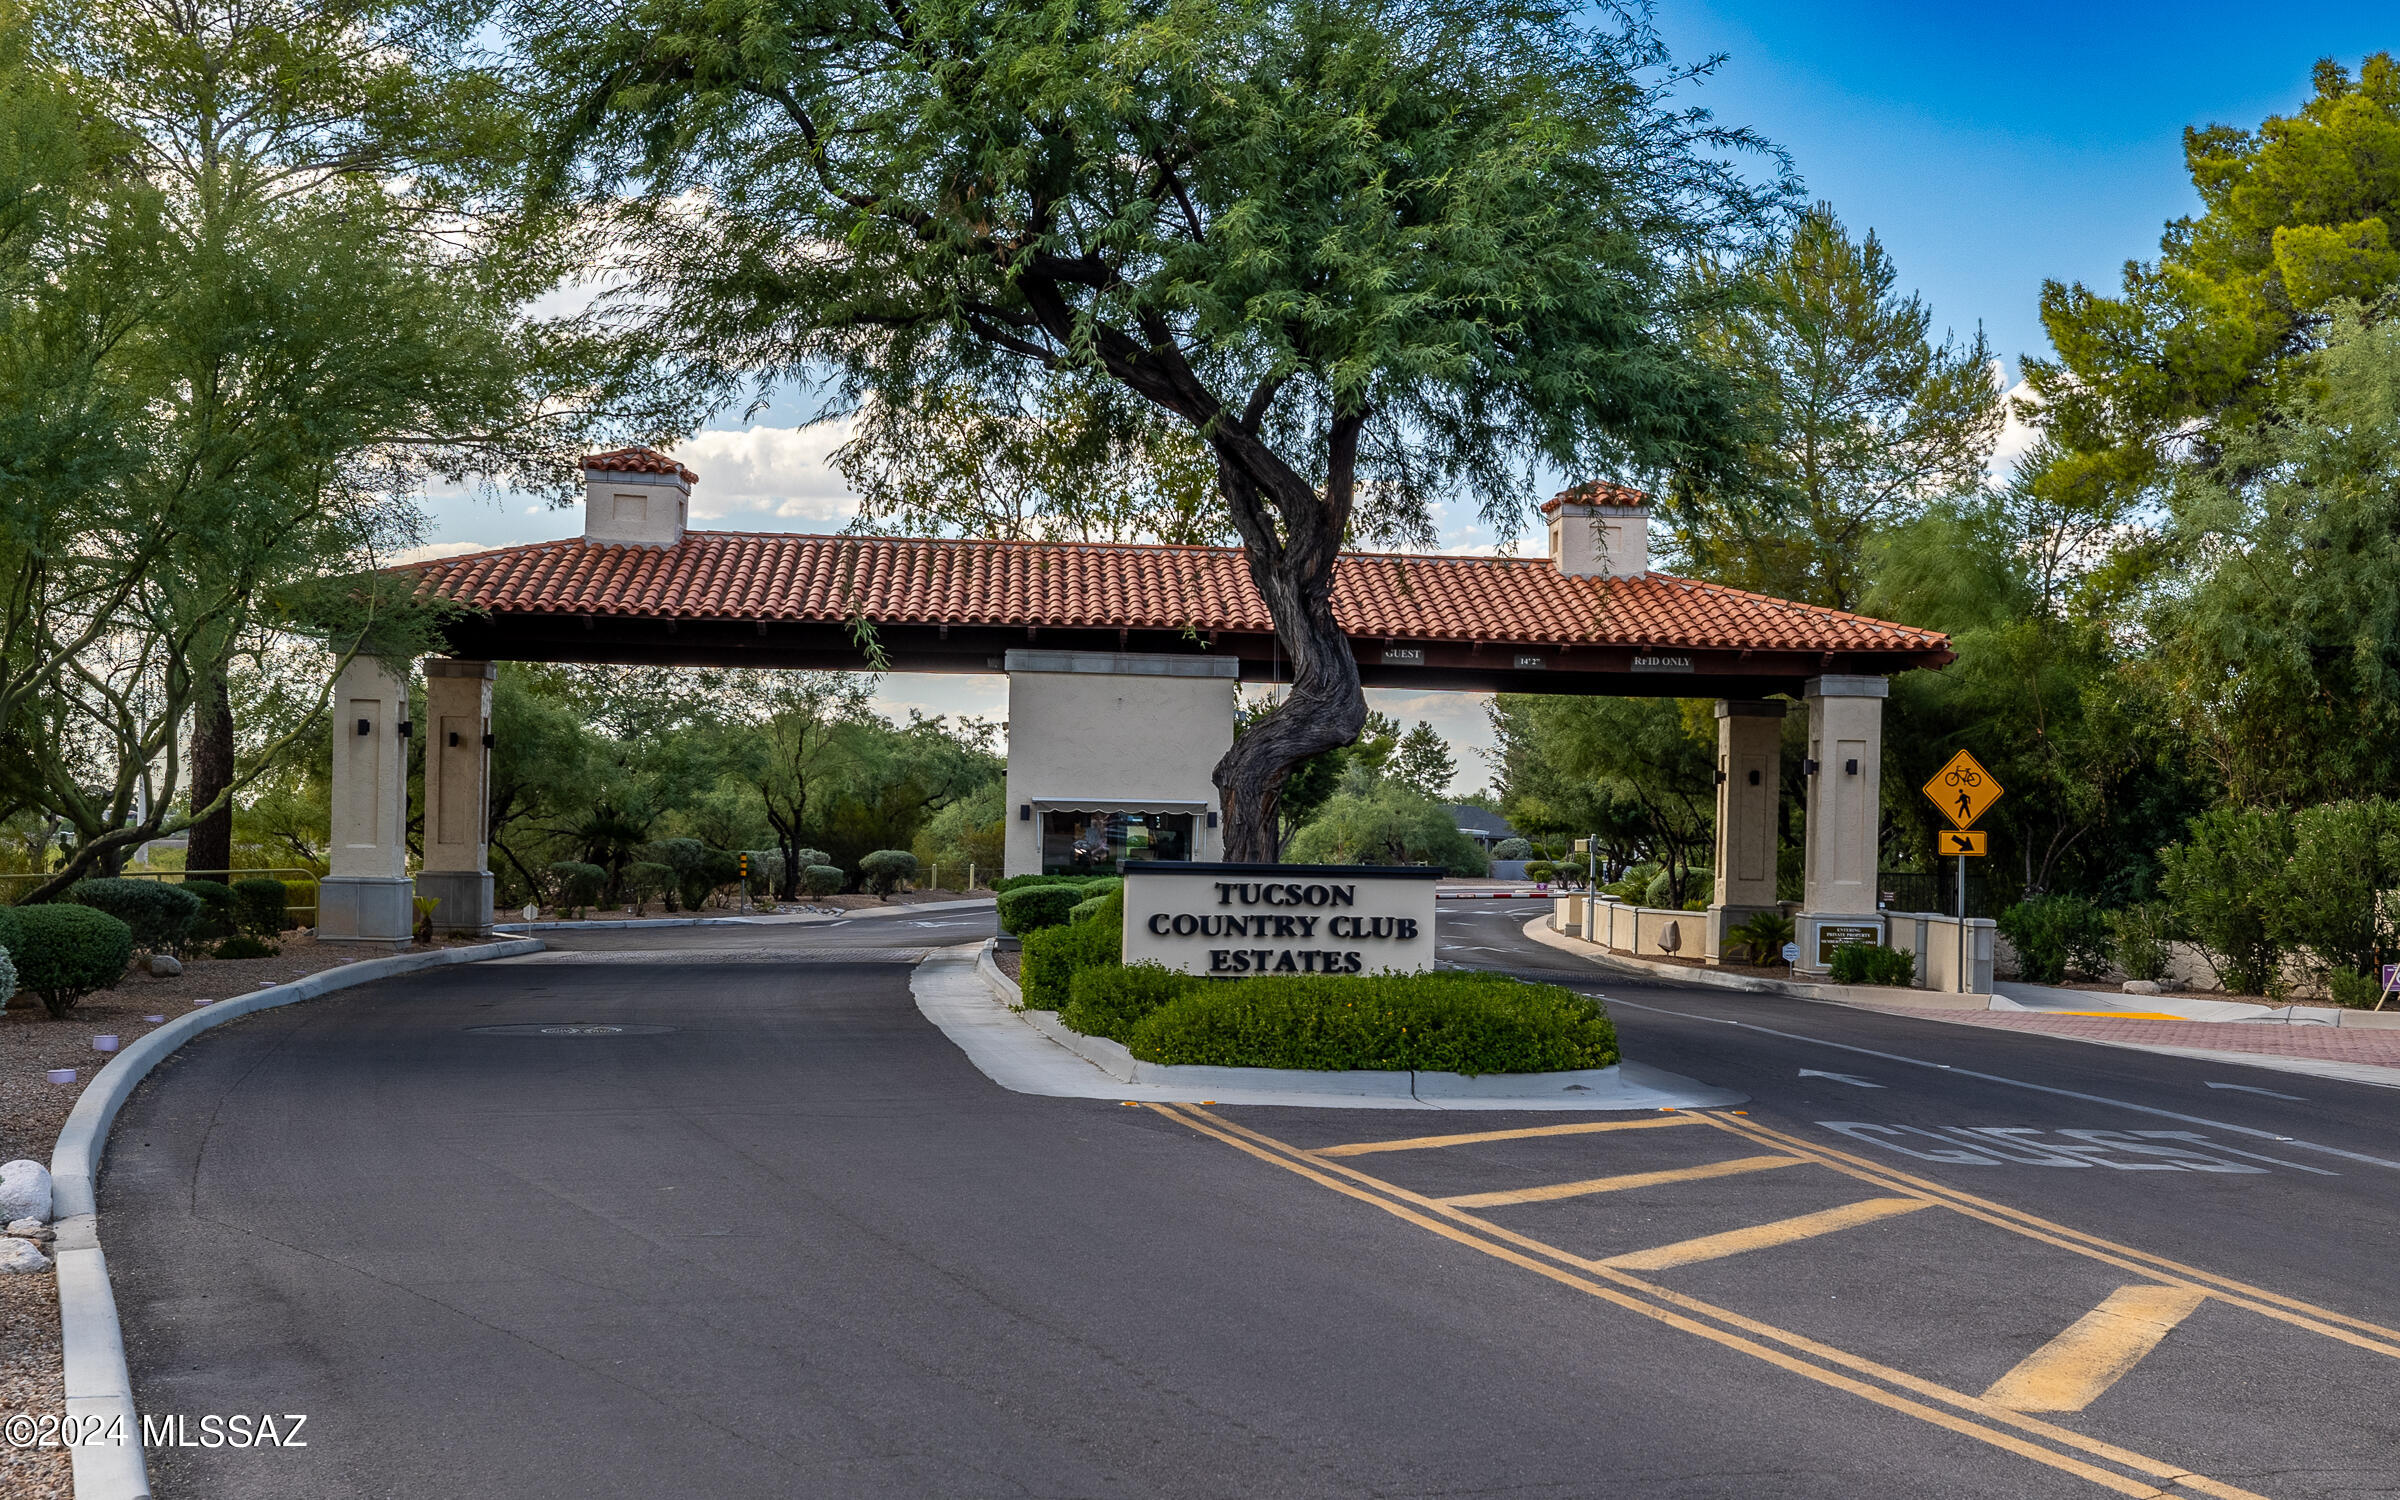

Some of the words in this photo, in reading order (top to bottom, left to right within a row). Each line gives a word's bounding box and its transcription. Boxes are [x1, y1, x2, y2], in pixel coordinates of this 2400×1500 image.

[1385, 649, 1421, 659] GUEST
[1661, 656, 1691, 666] ONLY
[1214, 881, 1356, 907] TUCSON
[1148, 913, 1320, 938] COUNTRY
[1328, 915, 1419, 940] CLUB
[1209, 949, 1362, 974] ESTATES
[1814, 1120, 2344, 1176] GUEST
